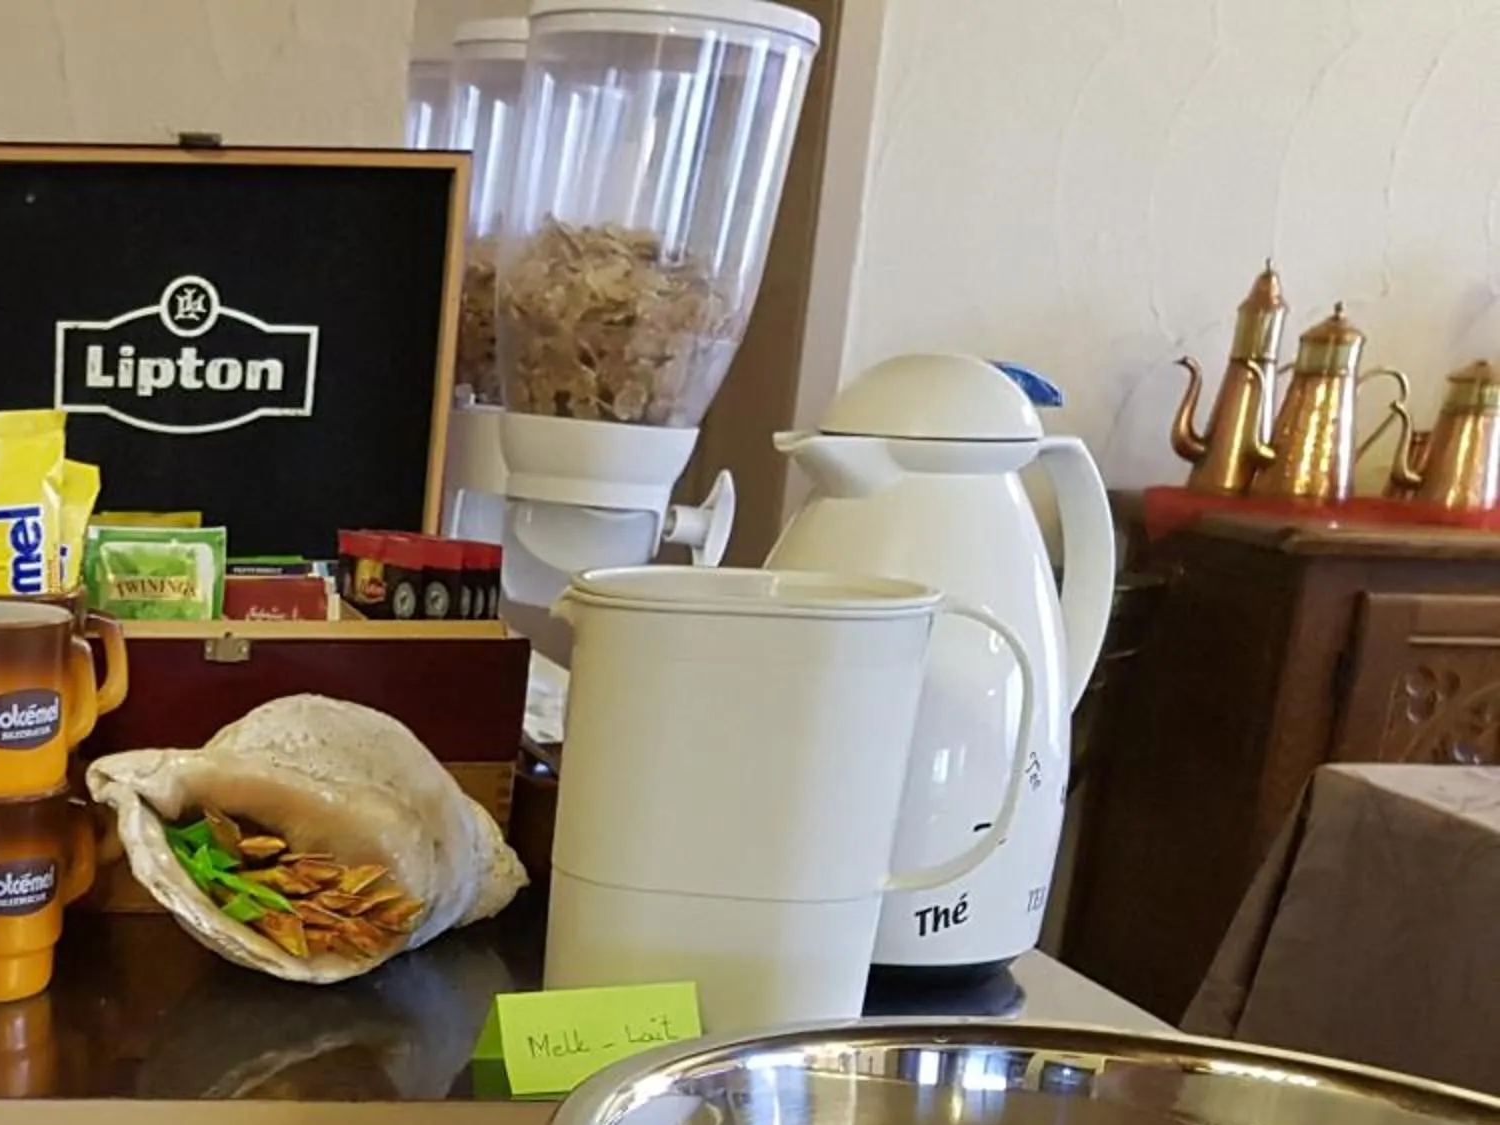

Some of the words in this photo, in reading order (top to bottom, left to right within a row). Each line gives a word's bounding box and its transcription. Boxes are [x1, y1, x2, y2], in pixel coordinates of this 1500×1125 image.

[85, 344, 284, 397] Lipton
[115, 578, 197, 598] TWININGS
[913, 892, 969, 937] Thé
[527, 1028, 591, 1059] Melk
